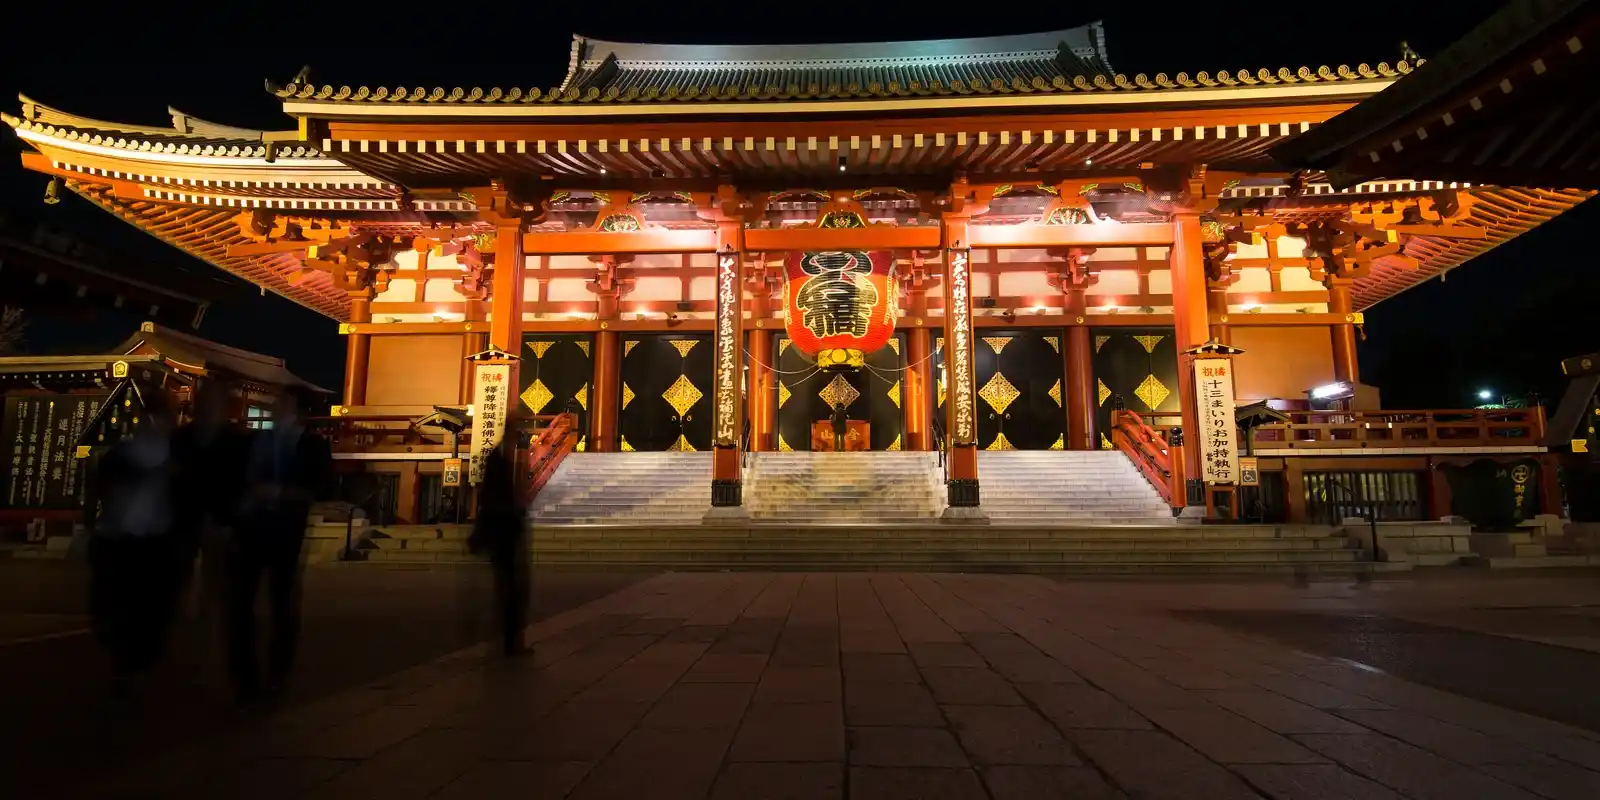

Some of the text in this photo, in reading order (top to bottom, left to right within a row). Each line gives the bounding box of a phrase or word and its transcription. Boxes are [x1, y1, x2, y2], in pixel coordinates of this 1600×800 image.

[1208, 380, 1231, 478] 十三まいりお加持執行
